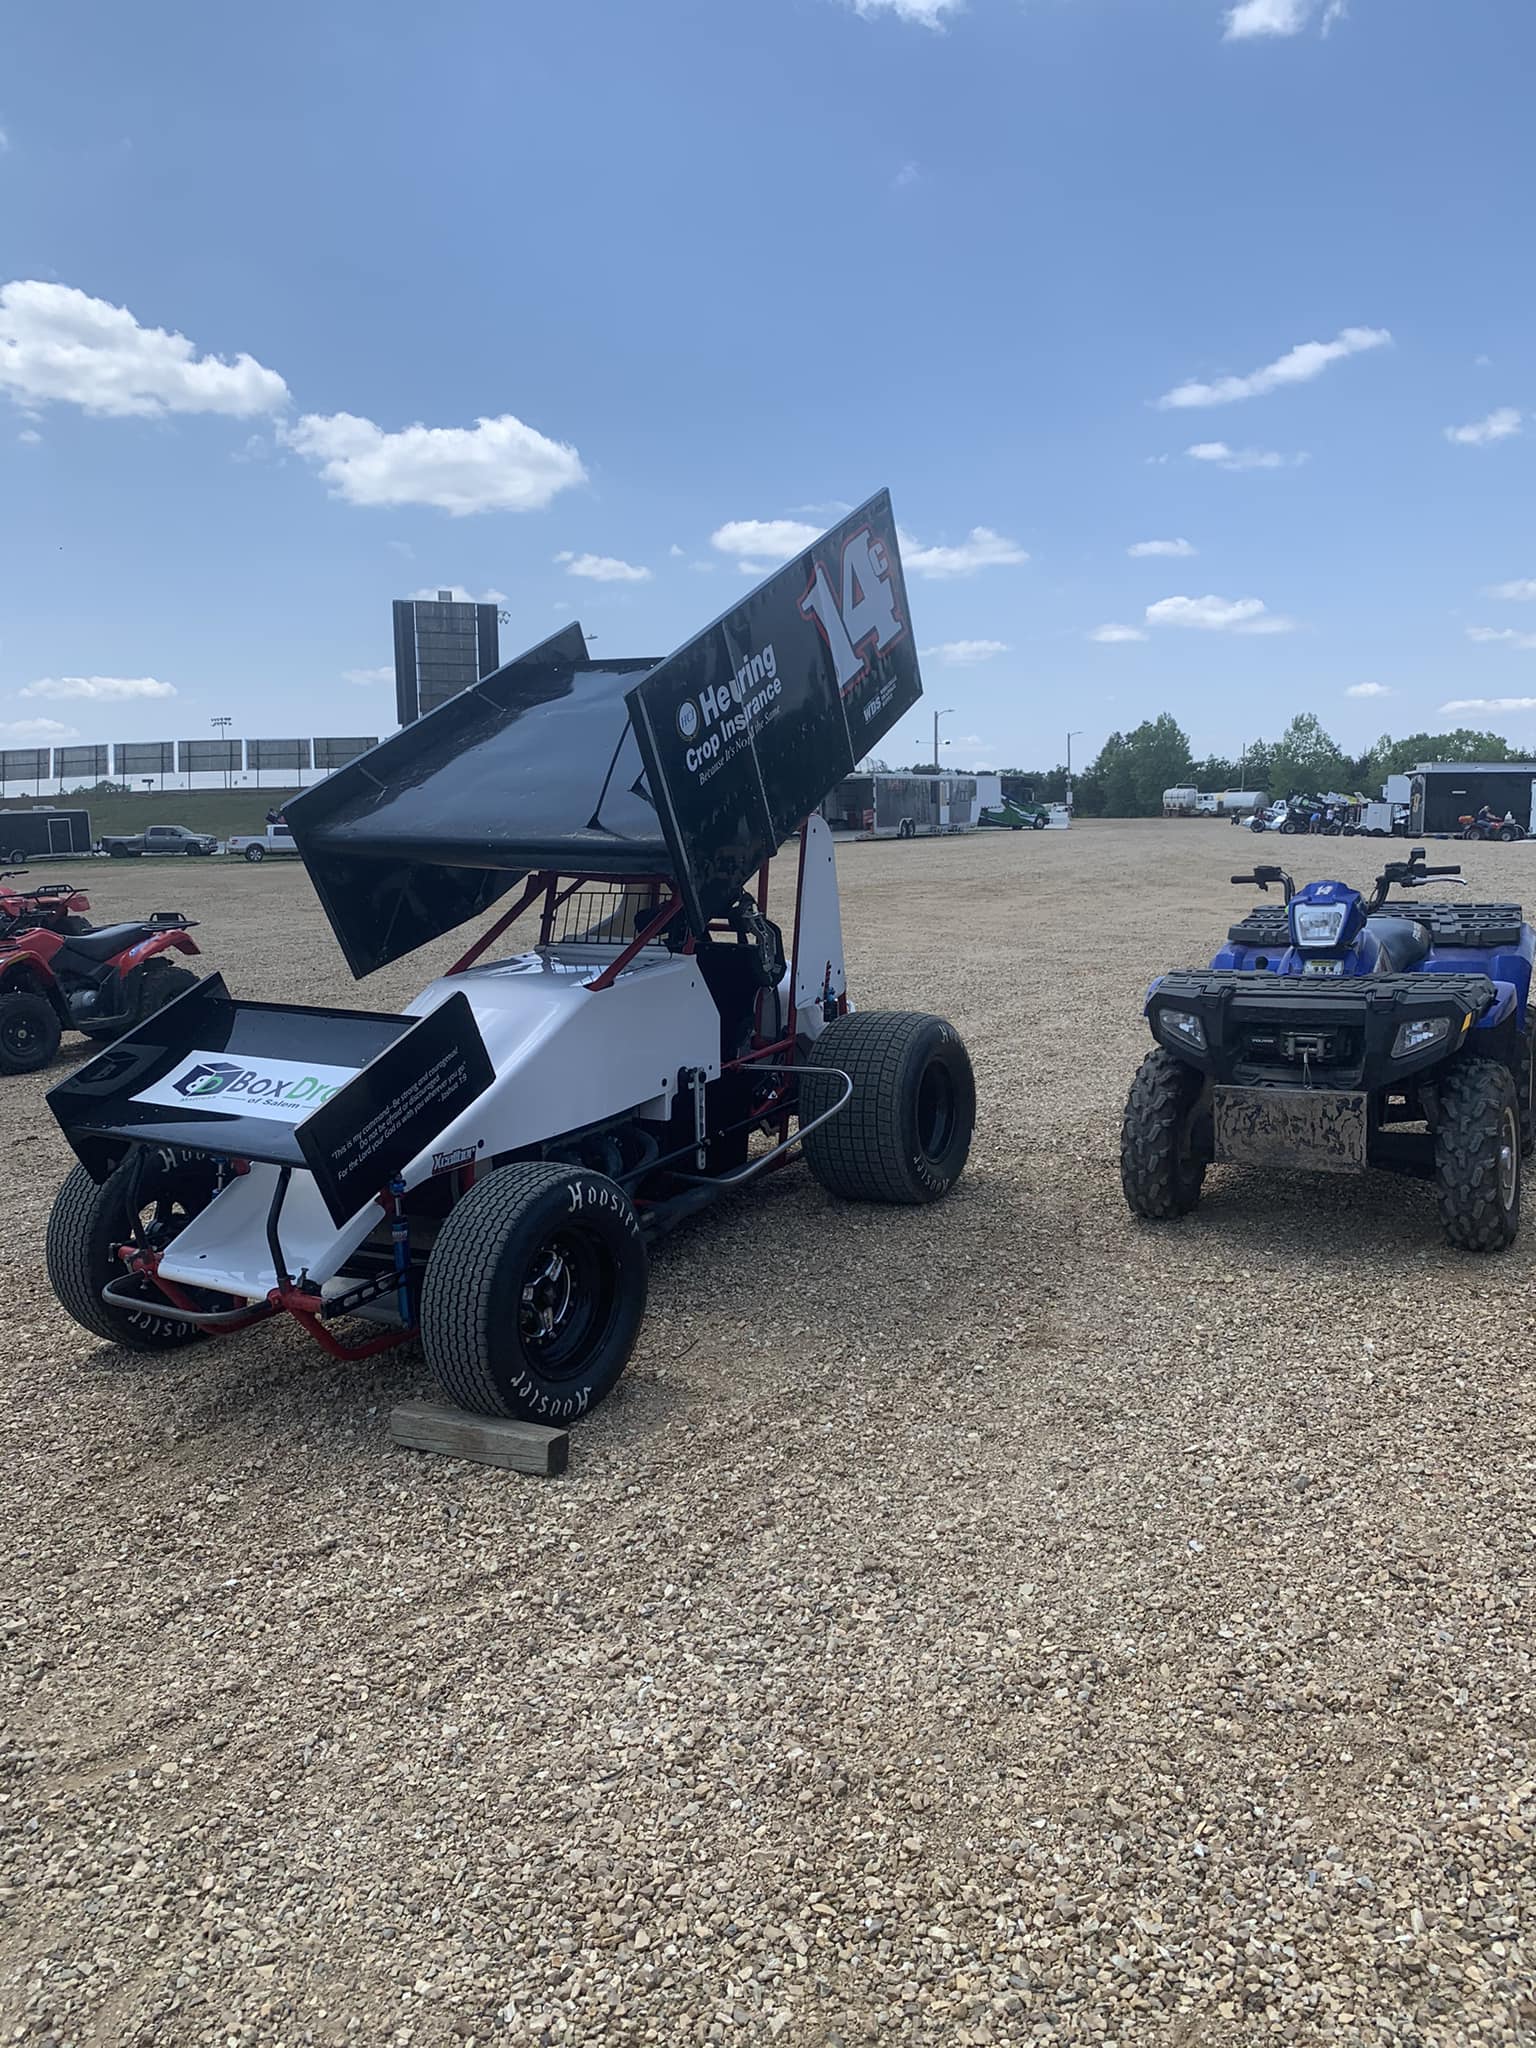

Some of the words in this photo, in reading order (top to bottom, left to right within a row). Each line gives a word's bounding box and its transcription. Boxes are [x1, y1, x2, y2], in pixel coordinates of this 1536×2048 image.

[698, 643, 777, 727] Heuring
[863, 695, 881, 721] WDS
[686, 733, 720, 772] Crop
[227, 1071, 342, 1103] BoxDro
[262, 1098, 300, 1109] Salem
[401, 1082, 419, 1101] strong
[418, 1071, 428, 1086] and
[338, 1167, 348, 1181] For
[348, 1158, 358, 1171] the
[358, 1144, 372, 1162] Lord
[372, 1135, 384, 1152] your
[384, 1122, 396, 1138] God
[401, 1109, 415, 1124] with
[414, 1100, 424, 1115] you
[448, 1071, 458, 1085] you
[359, 1138, 368, 1150] Do
[368, 1128, 378, 1142] not
[386, 1106, 402, 1126] afraid
[402, 1102, 408, 1112] or
